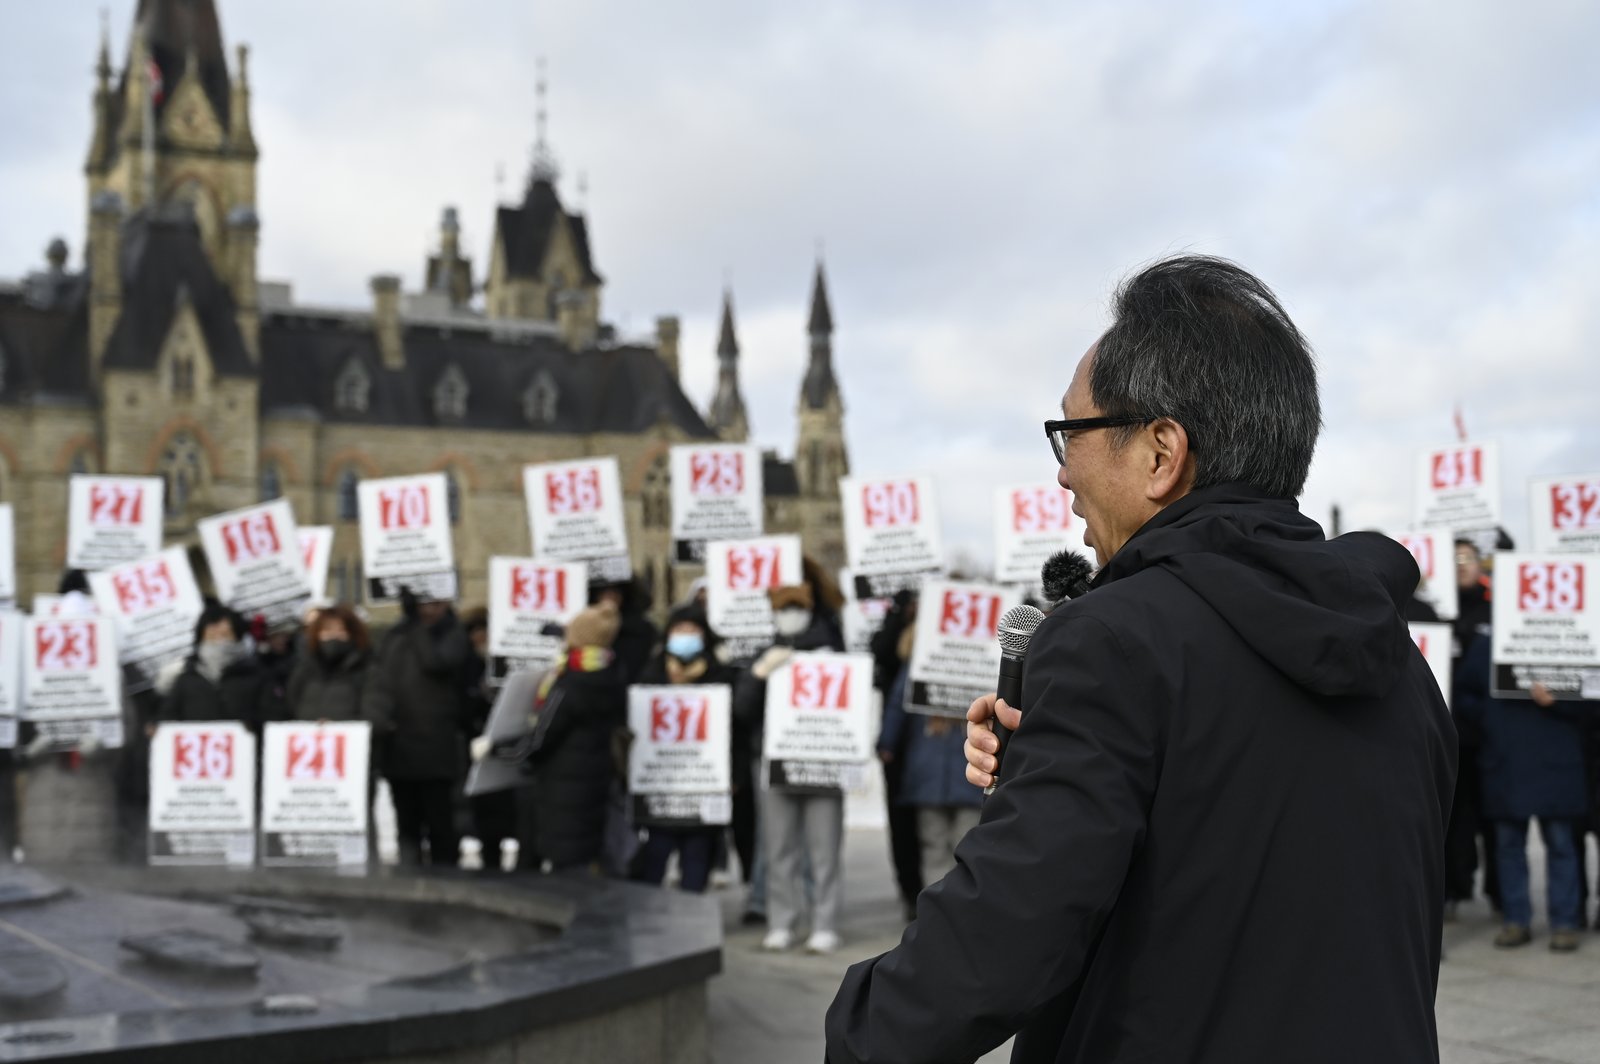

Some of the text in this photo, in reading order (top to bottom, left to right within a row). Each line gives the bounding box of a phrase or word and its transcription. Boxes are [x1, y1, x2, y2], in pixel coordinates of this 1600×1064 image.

[692, 454, 742, 490] 28
[1433, 448, 1481, 489] 41
[91, 487, 143, 524] 27
[380, 486, 430, 529] 70
[547, 470, 601, 513] 36
[864, 482, 918, 525] 90
[1014, 488, 1068, 530] 39
[222, 513, 281, 562] 16
[114, 563, 175, 611] 35
[512, 567, 566, 610] 31
[728, 548, 781, 591] 37
[1519, 563, 1583, 612] 38
[939, 591, 1000, 637] 31
[37, 624, 96, 667] 23
[791, 663, 850, 709] 37
[652, 698, 709, 742] 37
[175, 733, 233, 778] 36
[287, 732, 345, 778] 21
